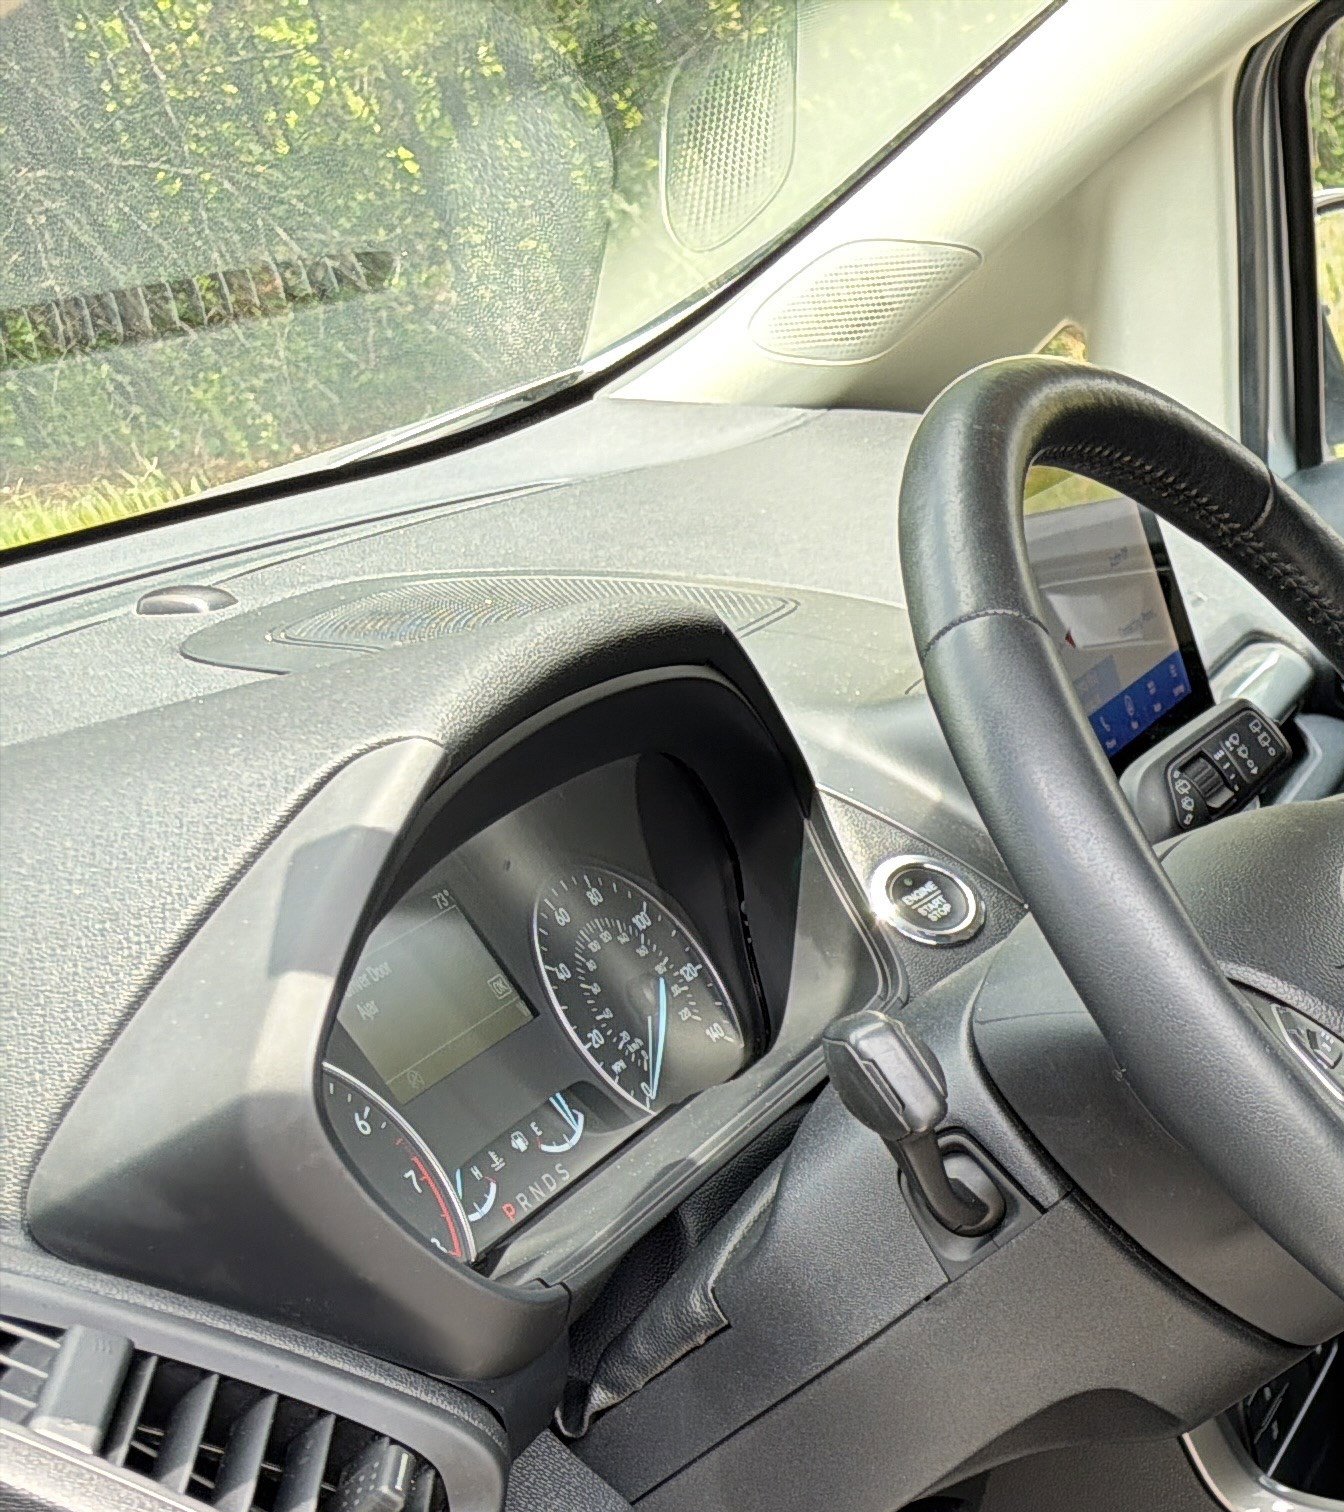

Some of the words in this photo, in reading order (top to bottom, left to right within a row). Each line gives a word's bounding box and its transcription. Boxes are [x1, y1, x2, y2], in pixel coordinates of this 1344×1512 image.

[586, 887, 604, 906] 80
[901, 880, 939, 906] ENGINE
[917, 894, 947, 917] START
[927, 902, 952, 922] STOP
[554, 907, 571, 927] 60
[632, 911, 651, 931] 100
[556, 962, 572, 982] 40
[679, 962, 699, 983] 120
[586, 1028, 605, 1049] 20
[705, 1022, 725, 1042] 140
[354, 1112, 372, 1135] 6
[530, 1121, 543, 1136] E
[403, 1169, 423, 1194] 7
[470, 1165, 484, 1181] H
